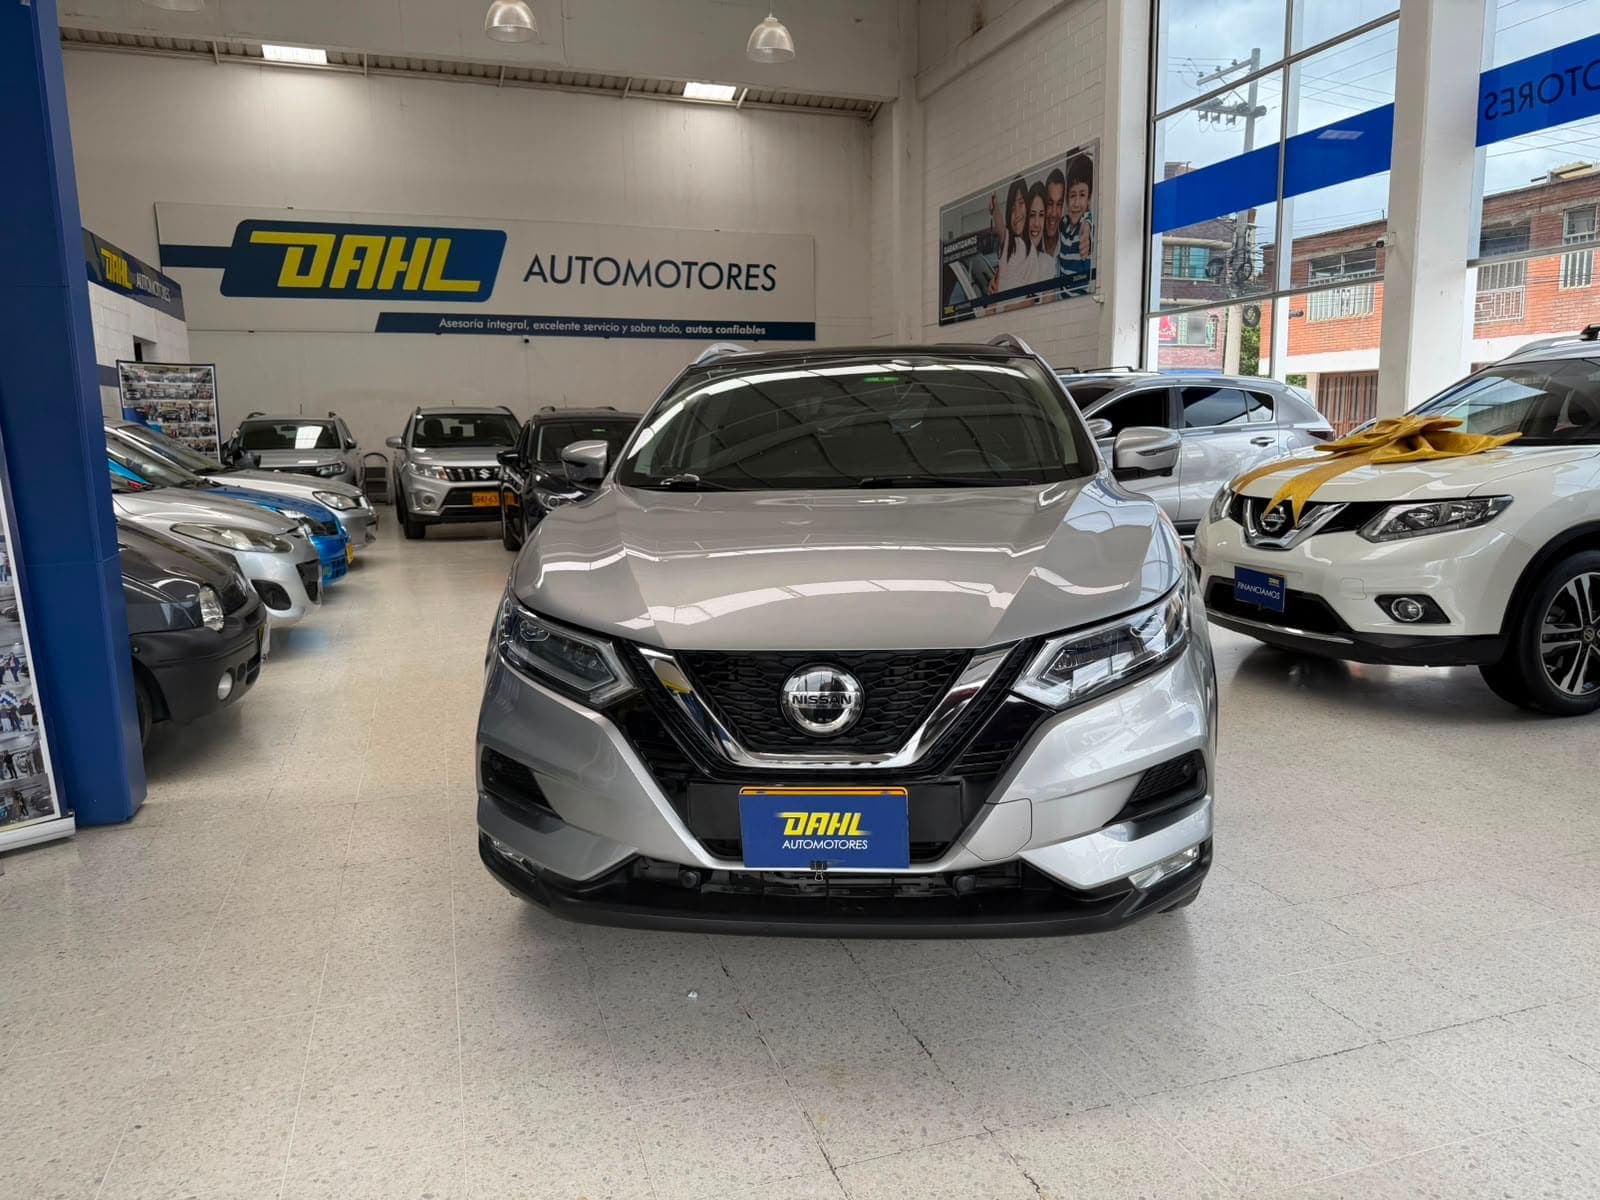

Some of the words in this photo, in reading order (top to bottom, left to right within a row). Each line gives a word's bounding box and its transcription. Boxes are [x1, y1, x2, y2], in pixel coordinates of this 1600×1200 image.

[101, 248, 133, 289] DAHL
[250, 231, 480, 292] DAHL
[523, 253, 777, 292] AUTOMOTORES
[438, 318, 484, 329] Asesoría
[487, 319, 530, 331] integral,
[533, 322, 582, 332] excelente
[583, 323, 620, 333] servicio
[622, 325, 628, 334] y
[630, 323, 657, 333] sobre
[659, 324, 682, 334] todo,
[685, 325, 713, 334] autos
[715, 325, 766, 335] confiables
[1237, 581, 1280, 600] FINANCIAMOS
[792, 695, 852, 705] NISSAN
[776, 812, 871, 836] DAHL
[782, 839, 868, 850] AUTOMOTORES
